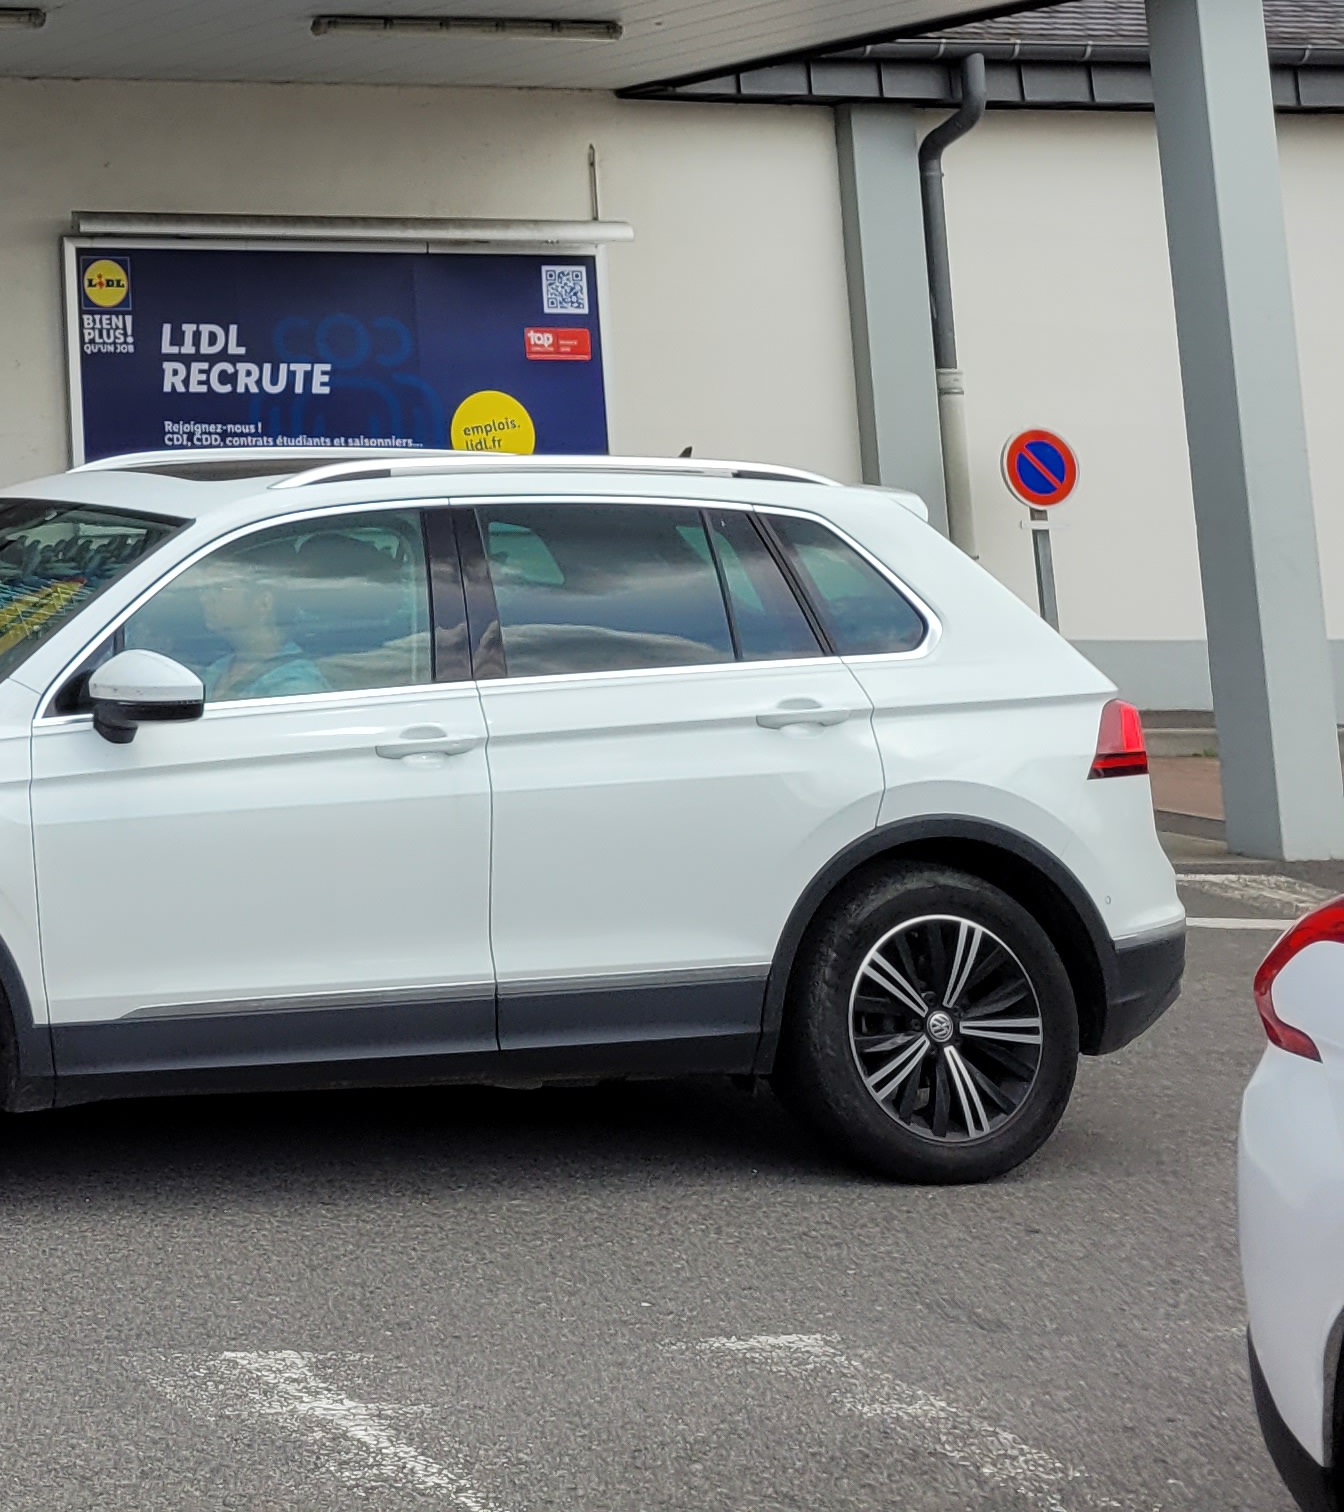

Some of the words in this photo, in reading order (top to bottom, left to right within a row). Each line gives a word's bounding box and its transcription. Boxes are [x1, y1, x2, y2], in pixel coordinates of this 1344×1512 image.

[82, 314, 123, 328] BIEN
[83, 329, 125, 343] PLUS
[161, 323, 246, 355] LIDL
[84, 343, 114, 354] QU'UN
[116, 344, 134, 353] JOB
[162, 361, 332, 395] RECRUTE
[164, 434, 191, 447] CDI,
[193, 434, 223, 447] CDD,
[225, 435, 273, 447] contrats
[275, 434, 331, 447] étudiants
[333, 435, 345, 447] et
[465, 435, 503, 451] lidl.fr
